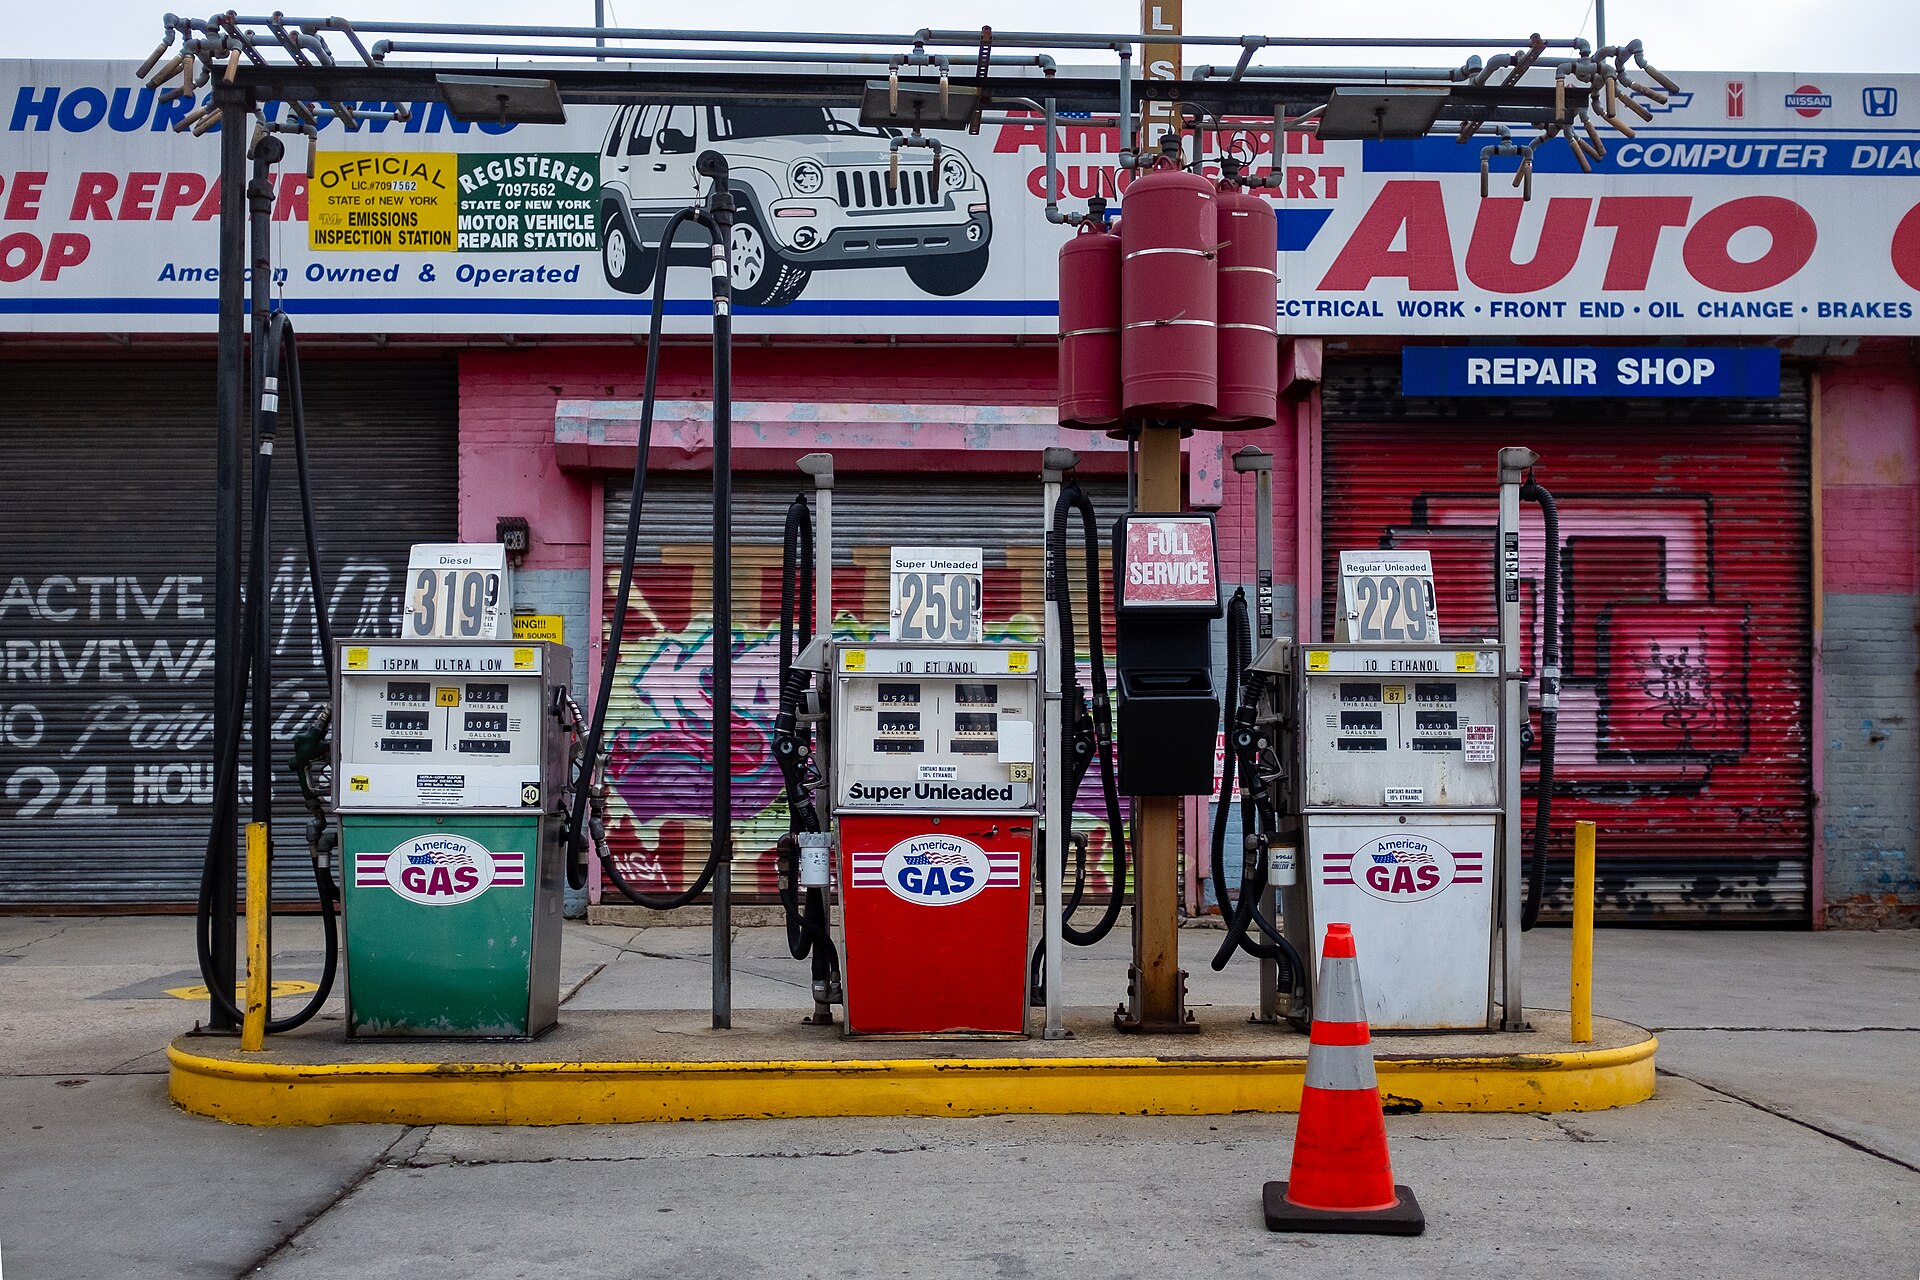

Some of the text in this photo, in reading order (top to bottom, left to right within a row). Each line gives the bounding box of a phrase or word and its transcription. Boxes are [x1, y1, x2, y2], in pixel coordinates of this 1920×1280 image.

[1787, 97, 1830, 106] NISSAN
[1616, 143, 1828, 169] COMPUTER
[320, 157, 446, 190] OFFICIAL
[458, 156, 594, 195] REGISTERED
[351, 180, 417, 192] LIC.#7097562
[496, 183, 556, 197] 7097562
[0, 172, 48, 220] E
[328, 195, 438, 206] STATE of NEW YORK
[461, 200, 591, 210] STATE OF NEW YORK
[348, 212, 418, 227] EMISSIONS
[458, 214, 595, 230] MOTOR VEHICLE
[314, 230, 451, 246] INSPECTION STATION
[458, 232, 596, 249] REPAIR STATION
[1315, 180, 1818, 294] AUTO
[305, 263, 400, 283] Owned
[418, 263, 436, 282] &
[455, 263, 580, 287] Operated
[1276, 300, 1913, 318] ECTRICAL WORK FRONT END OIL CHANGE BRAKES
[1467, 358, 1715, 386] REPAIR SHOP
[1147, 532, 1194, 555] FULL
[439, 556, 472, 565] Diesel
[895, 560, 978, 570] Super Unleaded
[1346, 563, 1427, 573] Regular Unleaded
[1129, 561, 1210, 585] SERVICE
[0, 575, 205, 622] ACTIVE
[413, 569, 485, 637] 319
[901, 573, 971, 641] 259
[1357, 576, 1428, 641] 229
[513, 619, 546, 629] NING!!!
[382, 659, 502, 671] 15PPM ULTRA LOW
[898, 661, 912, 673] 10
[1365, 660, 1440, 671] 10 ETHANOL
[440, 693, 454, 702] 40
[1389, 692, 1400, 701] 87
[1015, 769, 1027, 779] 93
[5, 766, 118, 819] 24
[524, 789, 537, 801] 40
[849, 782, 1013, 803] Super Unleaded
[414, 839, 467, 853] American
[910, 839, 962, 854] American
[1377, 838, 1428, 853] American
[401, 866, 479, 896] GAS
[897, 866, 975, 896] GAS
[1365, 865, 1440, 894] GAS
